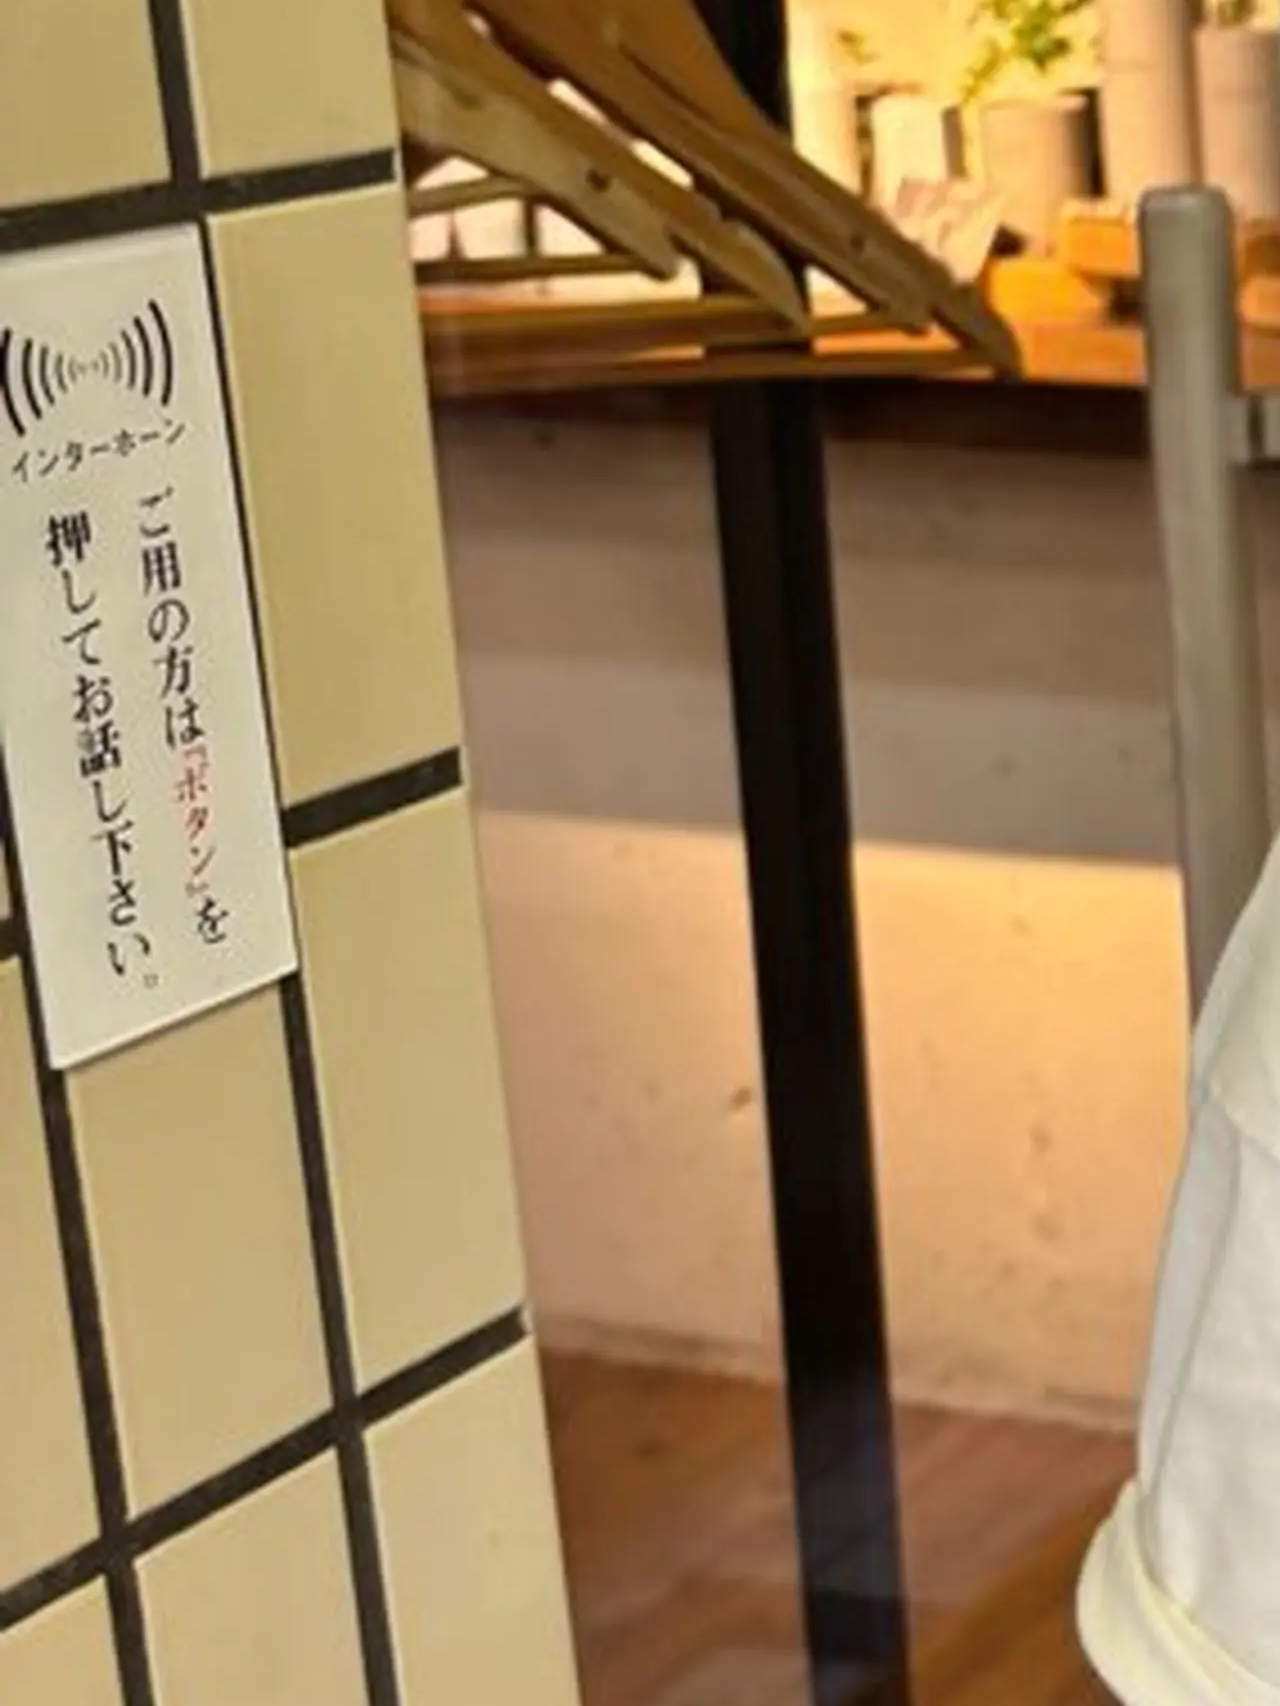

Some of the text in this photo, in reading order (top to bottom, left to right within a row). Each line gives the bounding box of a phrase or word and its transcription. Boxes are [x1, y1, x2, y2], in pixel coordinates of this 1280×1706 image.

[11, 417, 186, 483] インターホーン
